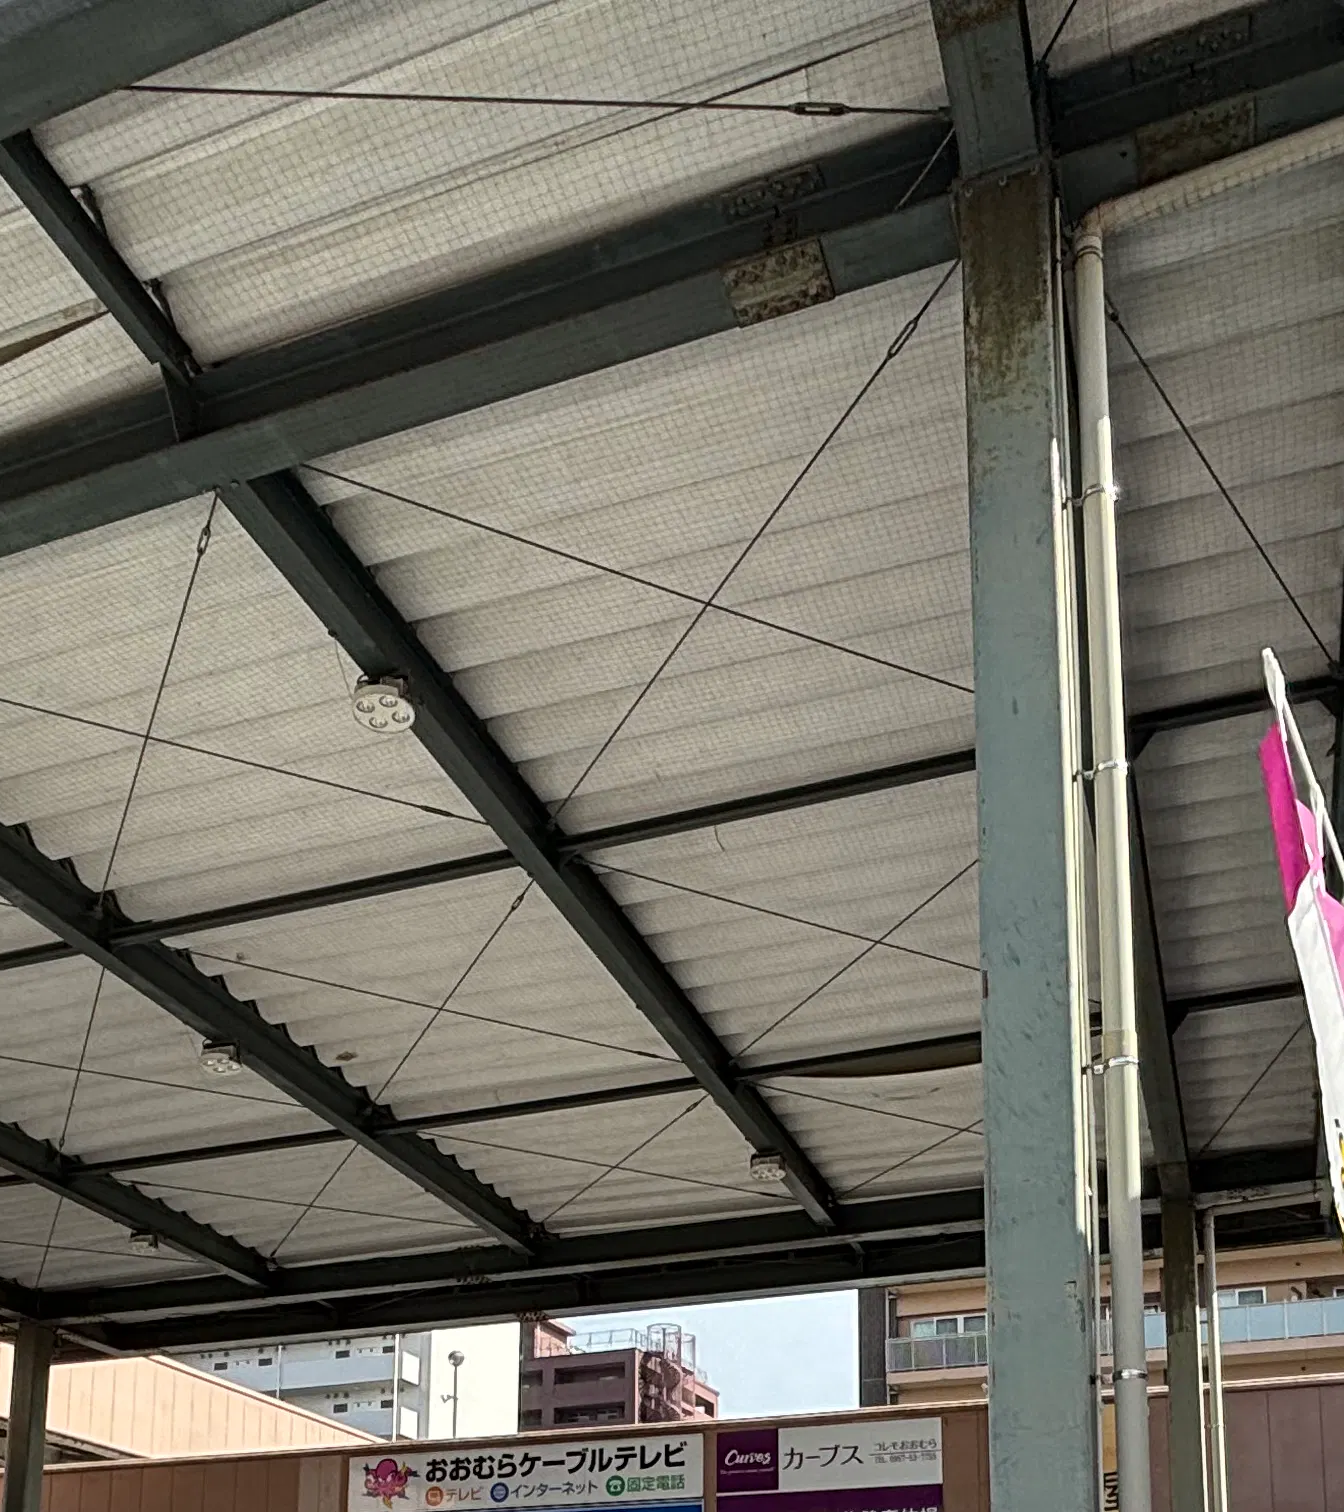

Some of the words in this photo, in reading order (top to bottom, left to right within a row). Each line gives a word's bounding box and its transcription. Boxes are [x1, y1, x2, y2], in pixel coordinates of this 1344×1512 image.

[425, 1441, 688, 1482] おおむらケーブルテレビ
[724, 1449, 771, 1467] Curves
[782, 1444, 864, 1470] カーブス
[443, 1485, 482, 1502] テレビ
[510, 1481, 599, 1500] インターネット
[626, 1474, 685, 1493] 固定電話
